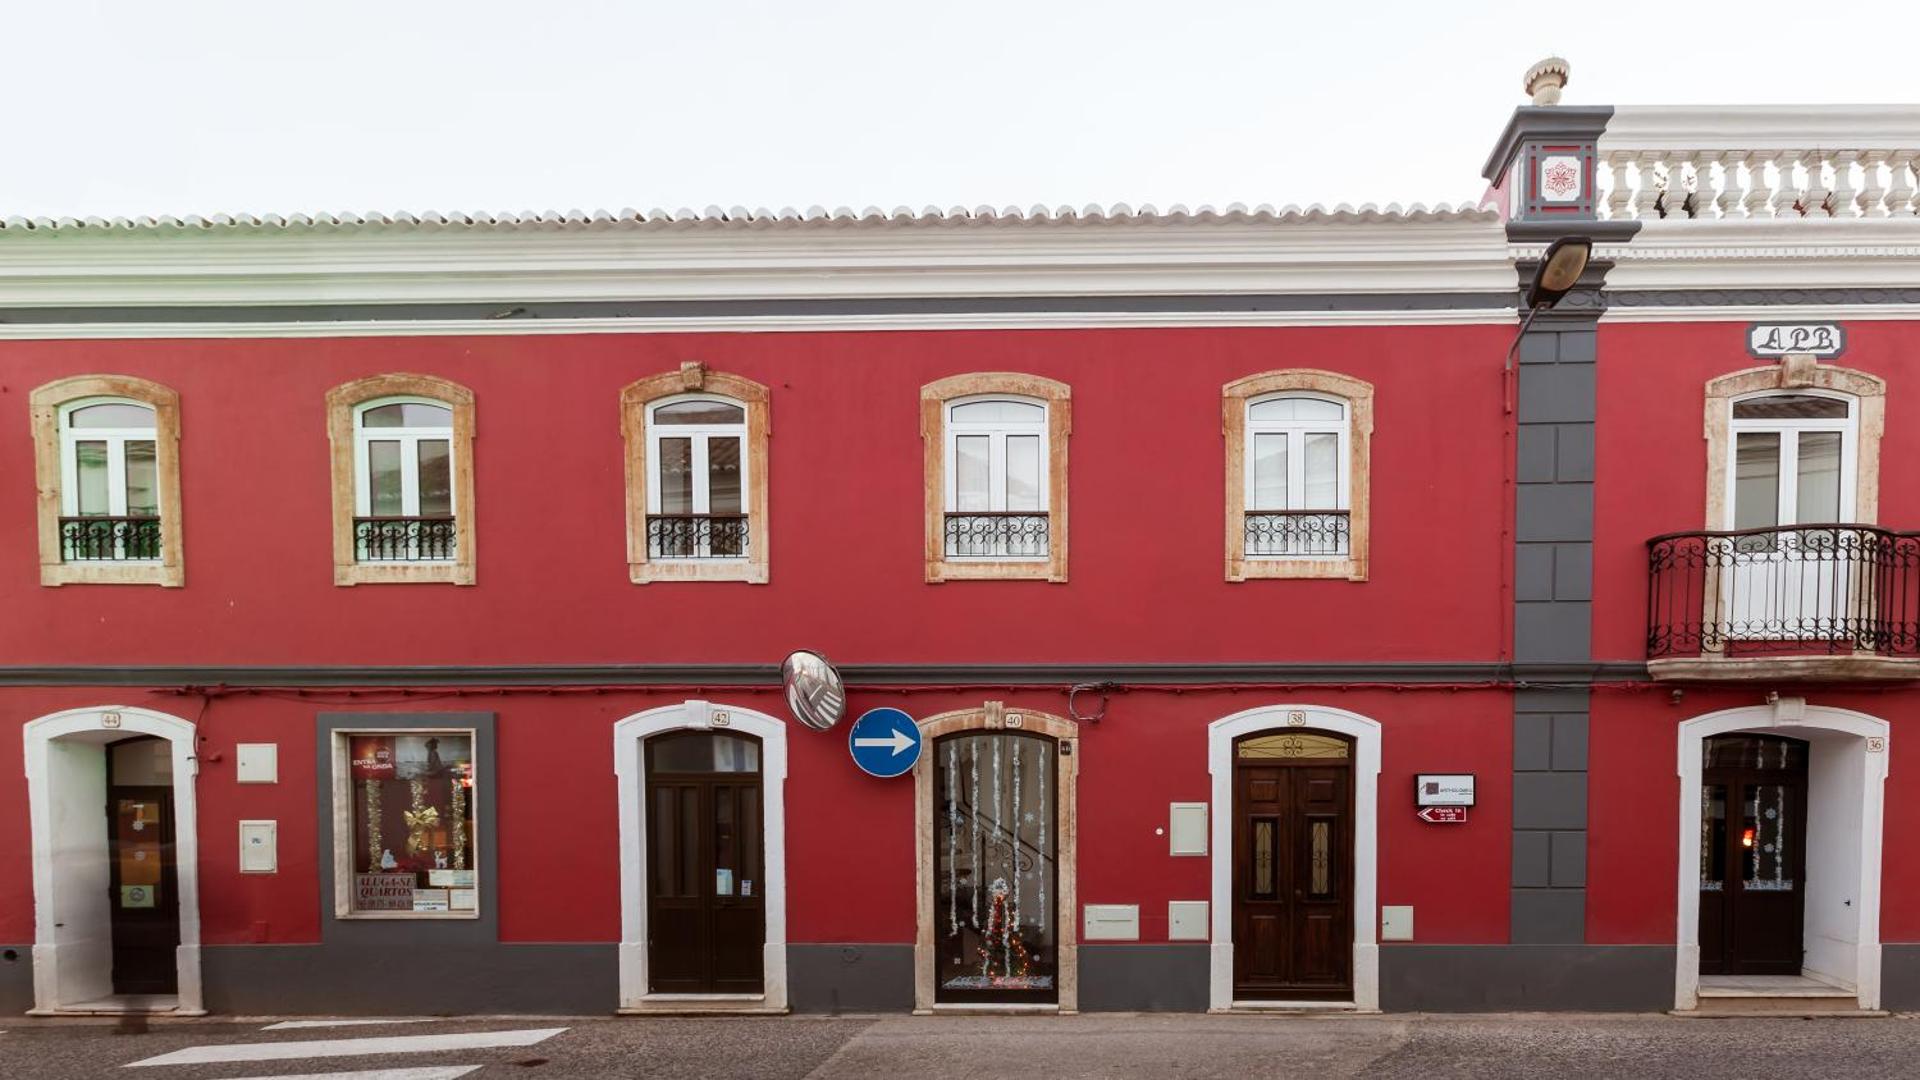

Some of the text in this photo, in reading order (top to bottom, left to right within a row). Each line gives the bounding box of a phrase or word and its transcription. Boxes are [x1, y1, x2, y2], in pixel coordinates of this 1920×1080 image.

[104, 714, 118, 724] 44
[715, 713, 727, 723] 42
[1007, 716, 1020, 726] 40
[1290, 713, 1303, 724] 38
[1869, 740, 1882, 751] 36
[360, 877, 412, 887] ALUGA-SE
[360, 887, 412, 898] QUARTOS
